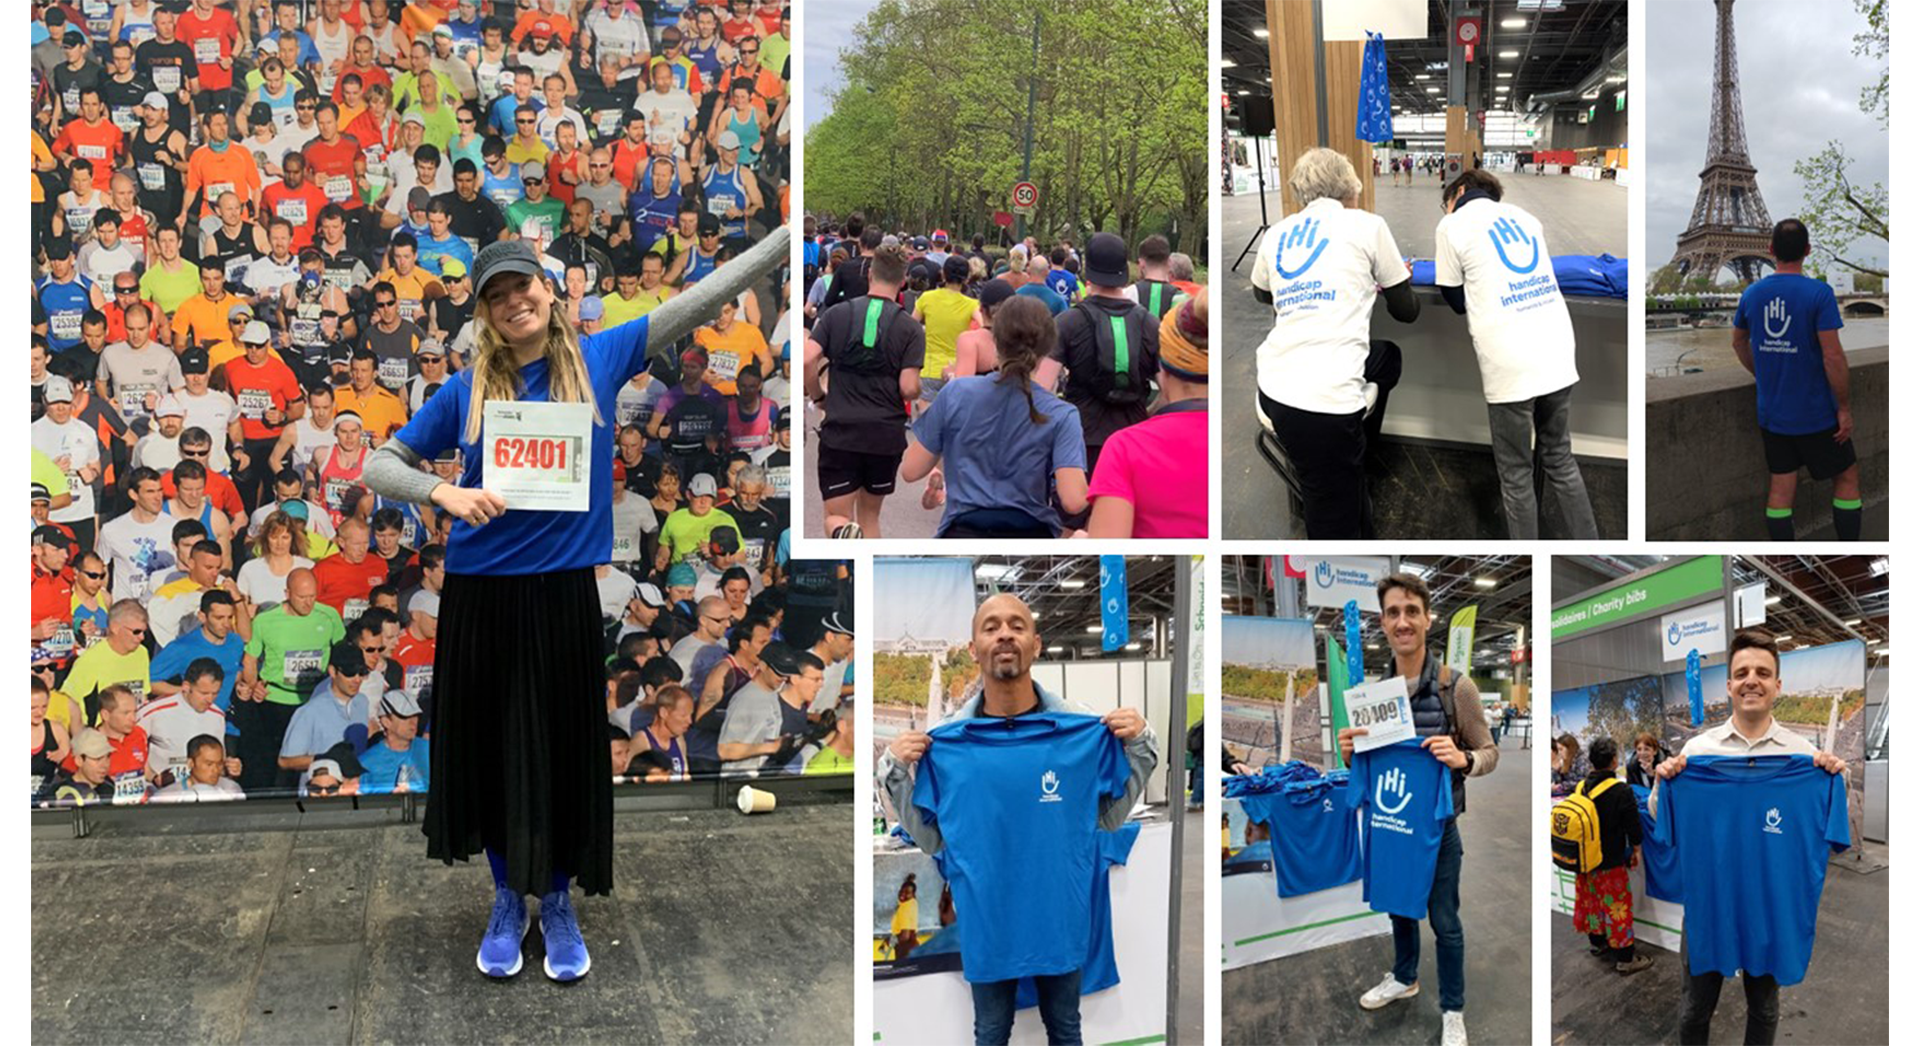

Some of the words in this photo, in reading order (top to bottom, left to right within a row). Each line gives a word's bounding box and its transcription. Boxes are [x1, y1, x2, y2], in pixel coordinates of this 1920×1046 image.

[1018, 189, 1033, 200] 50
[1508, 275, 1550, 292] handicap
[1770, 296, 1785, 322] Hi
[494, 437, 566, 469] 62401
[1336, 568, 1369, 581] handicap
[1336, 576, 1378, 588] internation
[1592, 596, 1626, 616] Charity
[1626, 589, 1647, 605] bibs
[1384, 767, 1406, 798] Hi
[1372, 813, 1407, 827] handicap
